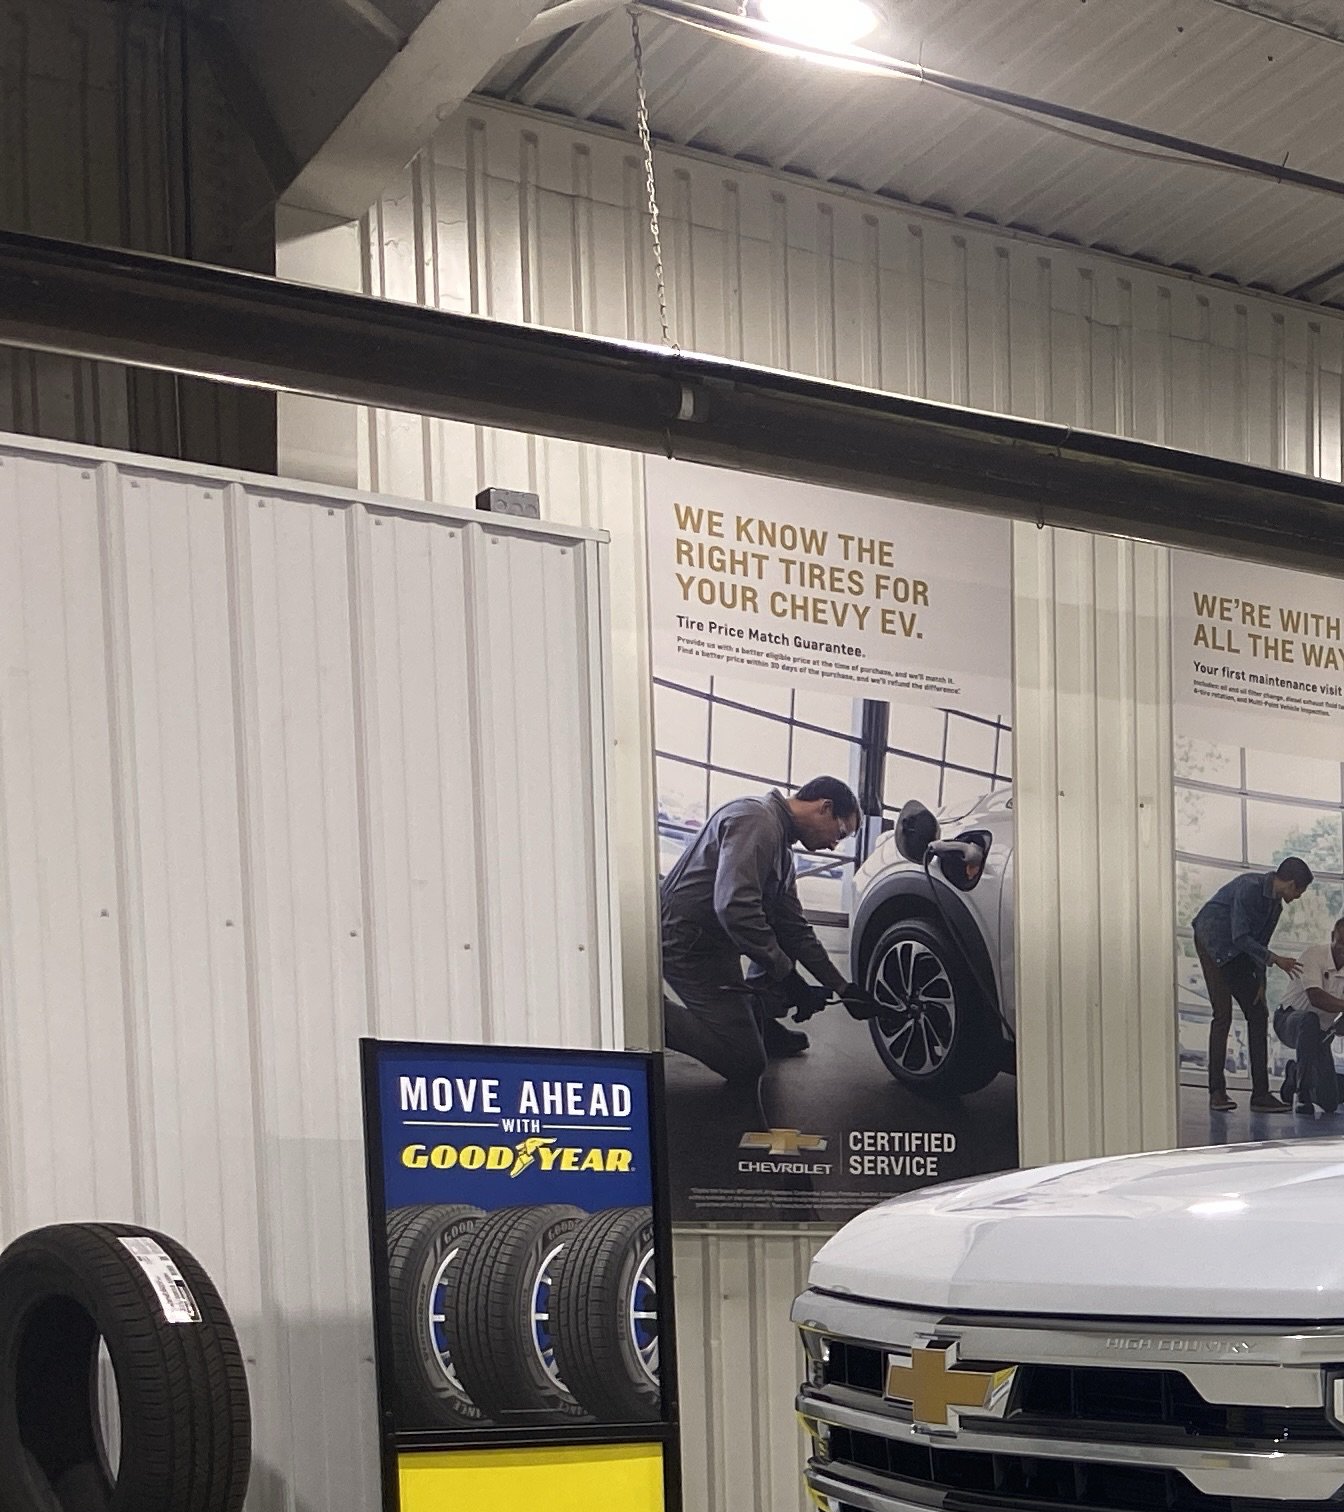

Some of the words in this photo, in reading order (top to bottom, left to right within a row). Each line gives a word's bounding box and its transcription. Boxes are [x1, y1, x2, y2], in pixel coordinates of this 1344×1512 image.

[673, 503, 724, 538] WE
[736, 516, 828, 555] KNOW
[837, 534, 894, 567] THE
[676, 539, 769, 578] RIGHT
[778, 558, 864, 595] TIRES
[875, 574, 929, 606] FOR
[675, 574, 758, 612] YOUR
[770, 592, 870, 629] CHEVY
[881, 608, 923, 639] EV.
[1193, 592, 1271, 628] WE'RE
[1279, 608, 1340, 640] WITH
[676, 615, 704, 631] Tire
[708, 621, 744, 638] Price
[748, 628, 789, 646] Match
[793, 636, 866, 657] Guarantee.
[1193, 623, 1240, 653] ALL
[1247, 633, 1294, 663] THE
[1193, 660, 1218, 676] Your
[1222, 666, 1246, 681] first
[1248, 674, 1317, 692] maintenance
[1319, 683, 1342, 696] visit
[400, 1076, 501, 1113] MOVE
[519, 1081, 632, 1117] AHEAD
[501, 1119, 541, 1133] WITH
[849, 1131, 957, 1153] CERTIFIED
[402, 1139, 635, 1176] GOODYEAR
[739, 1161, 833, 1175] CHEVROLET
[849, 1155, 939, 1177] SERVICE
